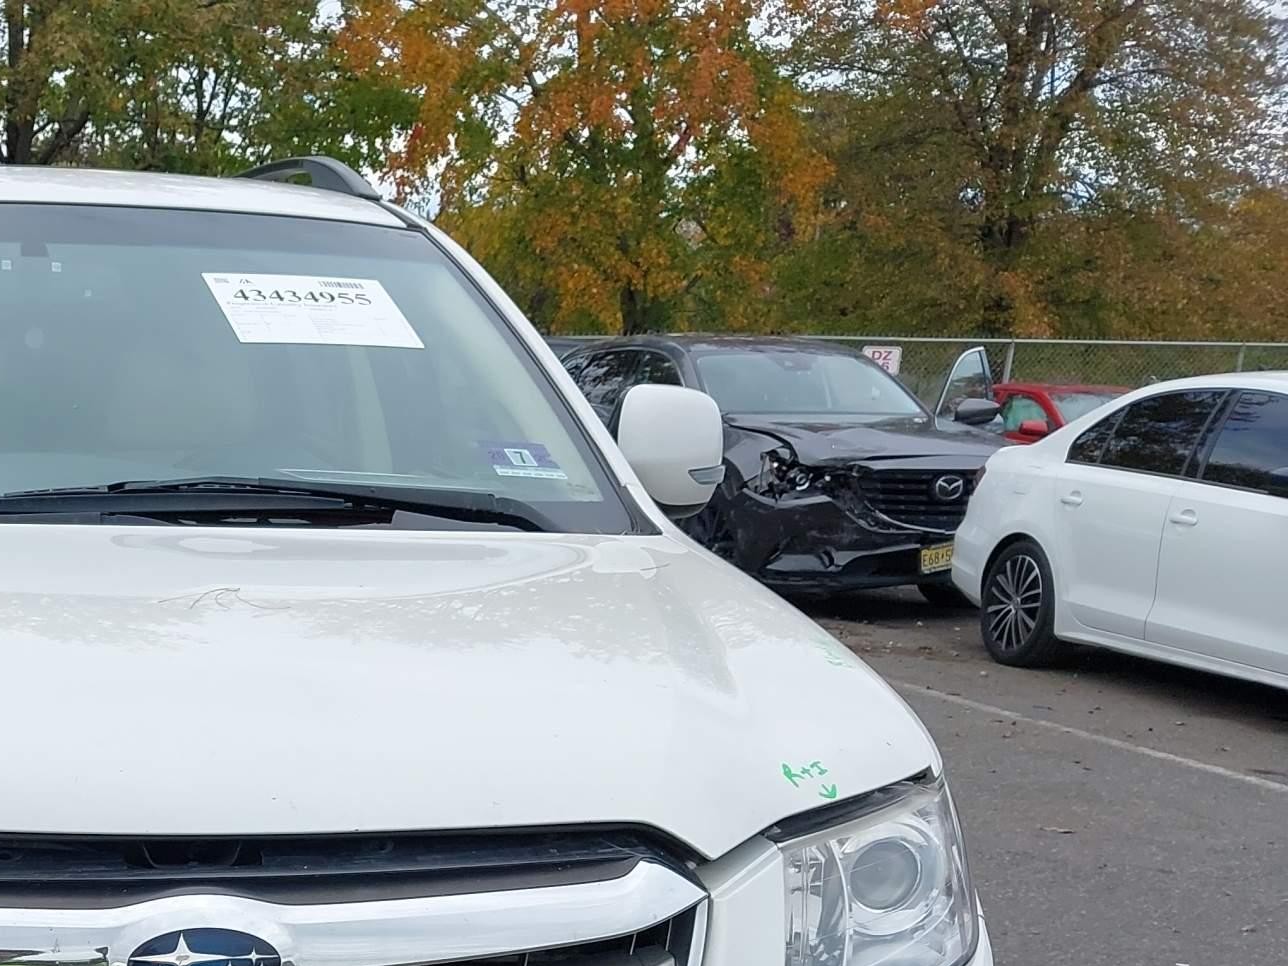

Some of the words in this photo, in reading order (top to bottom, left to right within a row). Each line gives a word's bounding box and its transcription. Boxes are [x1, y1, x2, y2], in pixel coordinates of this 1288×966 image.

[232, 288, 373, 306] 43434955
[871, 350, 893, 361] DZ
[513, 450, 526, 465] 7
